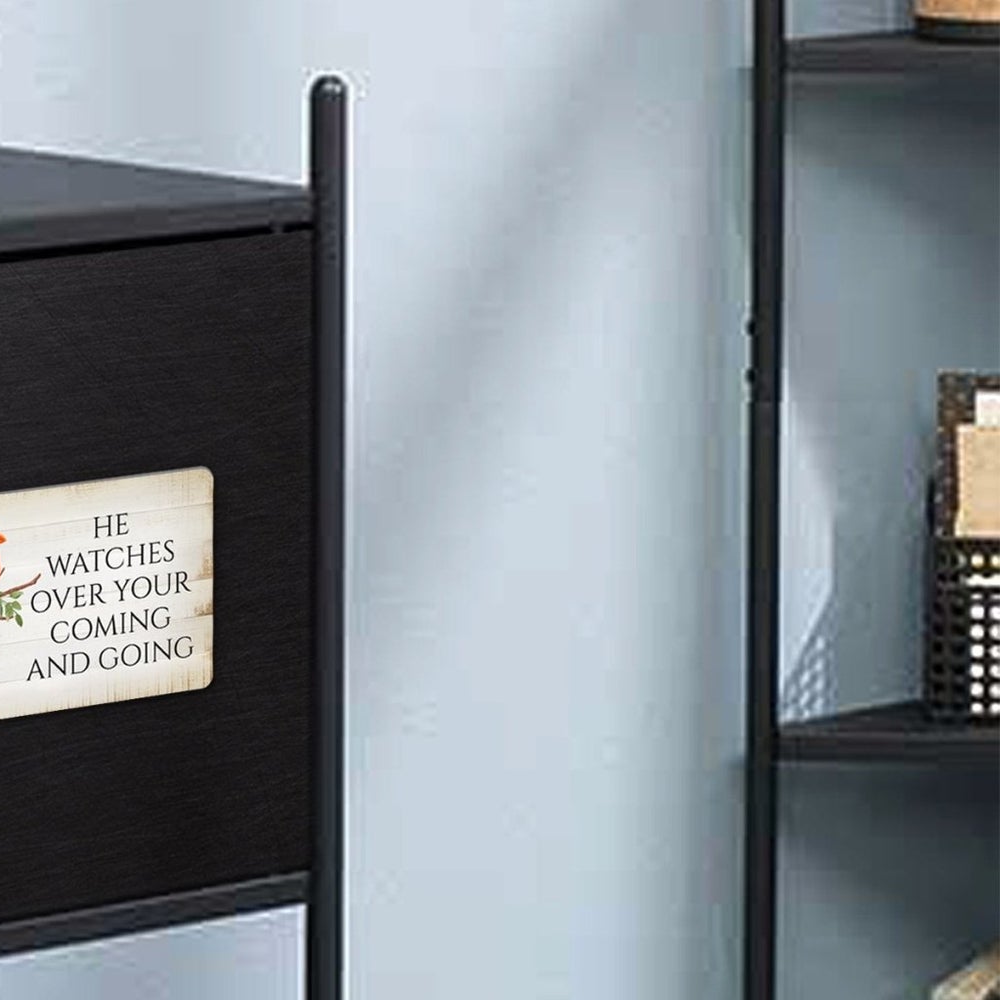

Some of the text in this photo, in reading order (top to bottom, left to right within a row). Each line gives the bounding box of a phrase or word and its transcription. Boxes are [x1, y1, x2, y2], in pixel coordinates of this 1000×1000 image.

[93, 513, 130, 540] HE
[46, 539, 175, 578] WATCHES
[30, 571, 192, 614] OVER YOUR
[50, 606, 171, 644] COMING
[26, 636, 194, 681] AND GOING
